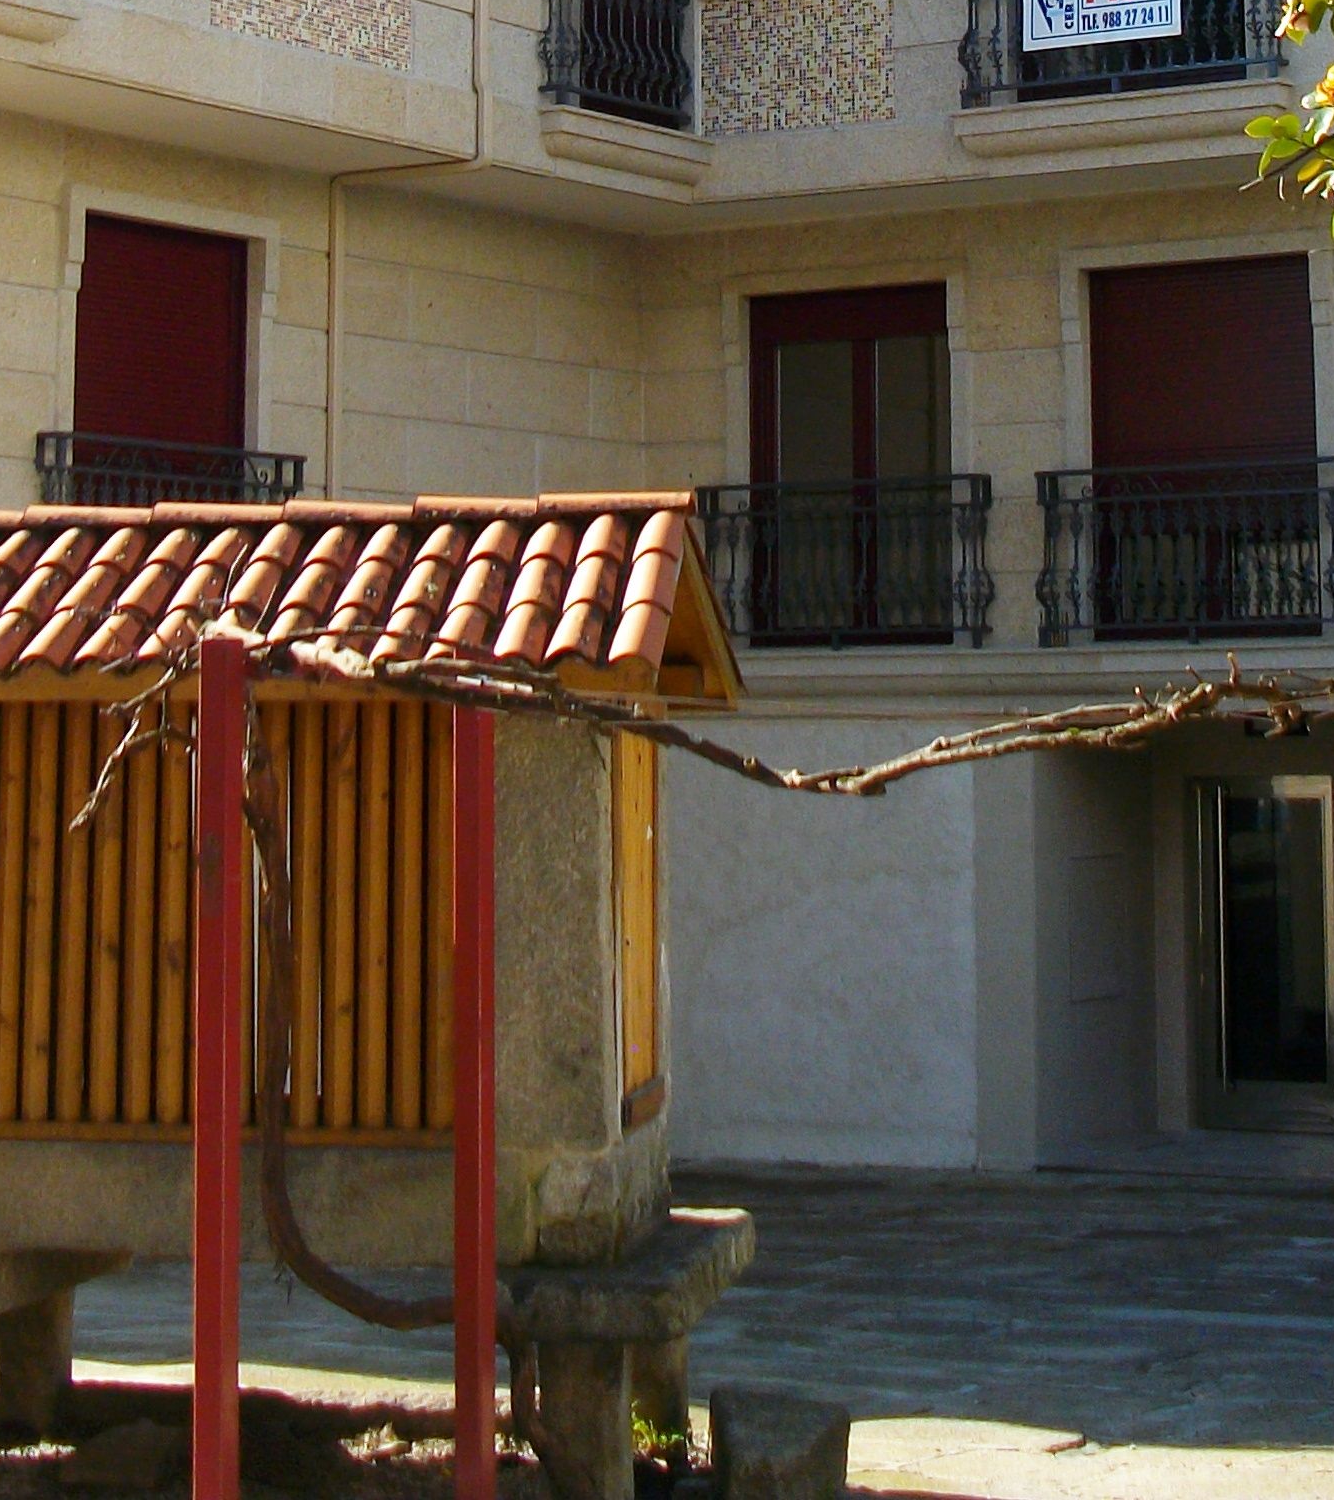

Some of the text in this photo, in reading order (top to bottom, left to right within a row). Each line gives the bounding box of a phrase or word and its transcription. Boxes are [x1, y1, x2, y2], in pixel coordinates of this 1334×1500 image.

[1064, 5, 1074, 30] CER
[1082, 5, 1169, 31] TLF. 988 27 24 11
